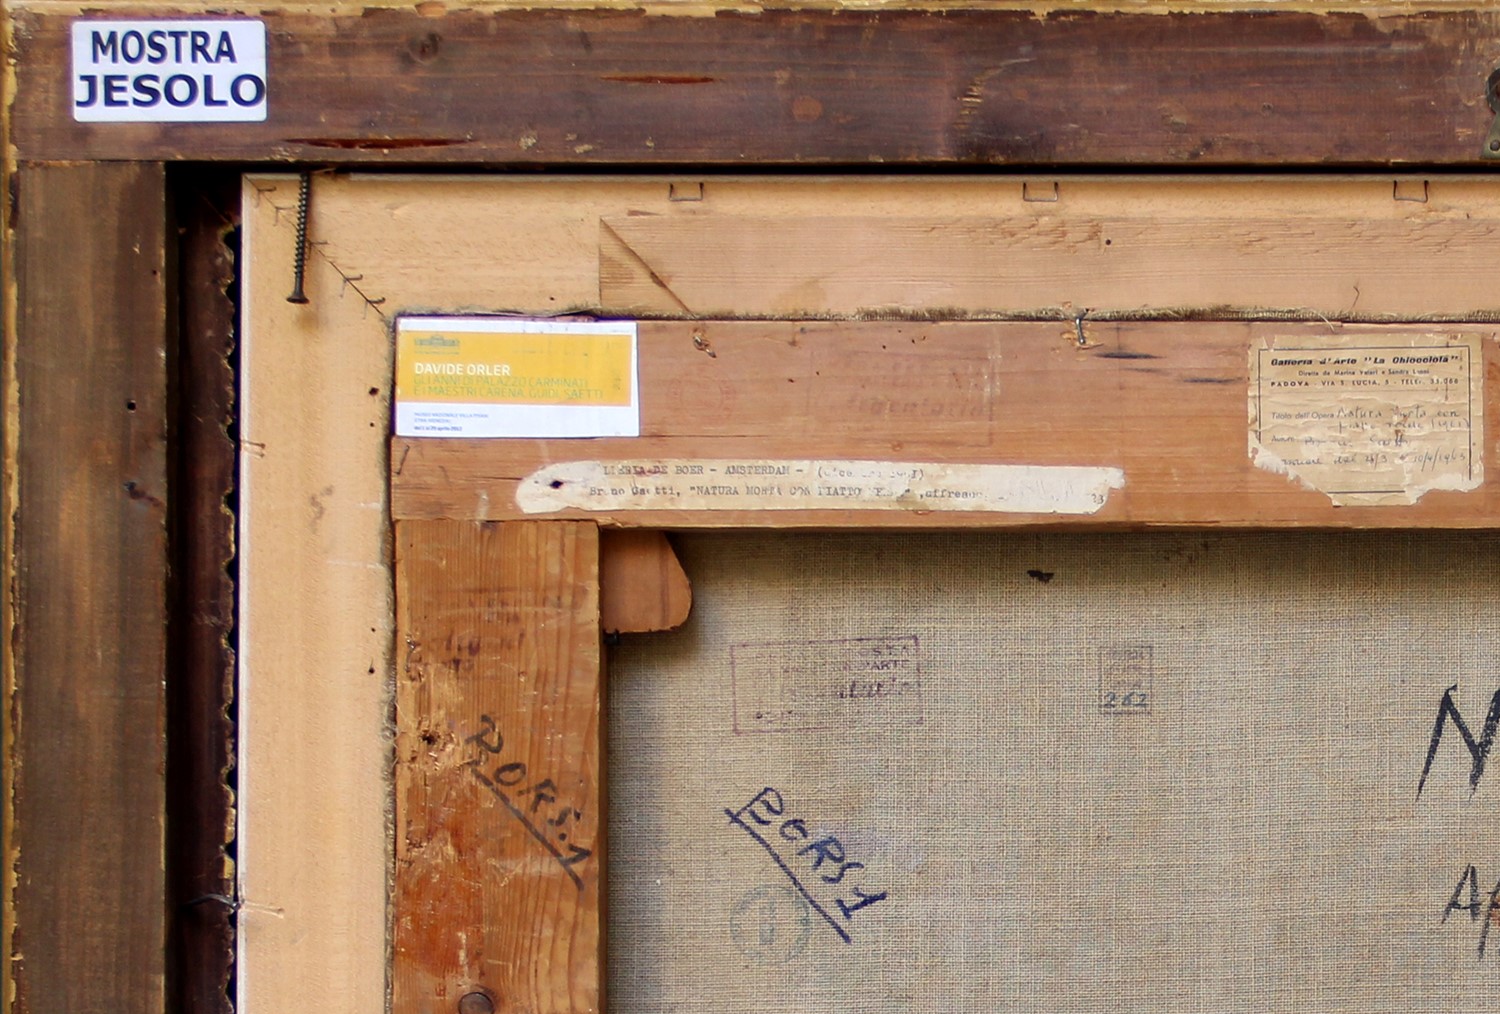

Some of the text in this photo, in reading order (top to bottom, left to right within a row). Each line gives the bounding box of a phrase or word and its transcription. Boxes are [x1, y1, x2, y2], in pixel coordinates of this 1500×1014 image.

[92, 30, 237, 64] MOSTRA
[75, 74, 265, 108] JESOLO
[414, 362, 511, 376] DAVIDE ORLER
[476, 377, 526, 387] PALAZZO
[528, 378, 588, 388] CARMINATI
[428, 387, 477, 397] MAESTRI
[566, 390, 603, 400] SAETTI
[1271, 412, 1292, 420] Titolo
[675, 465, 790, 476] BOER AMSTERDAM
